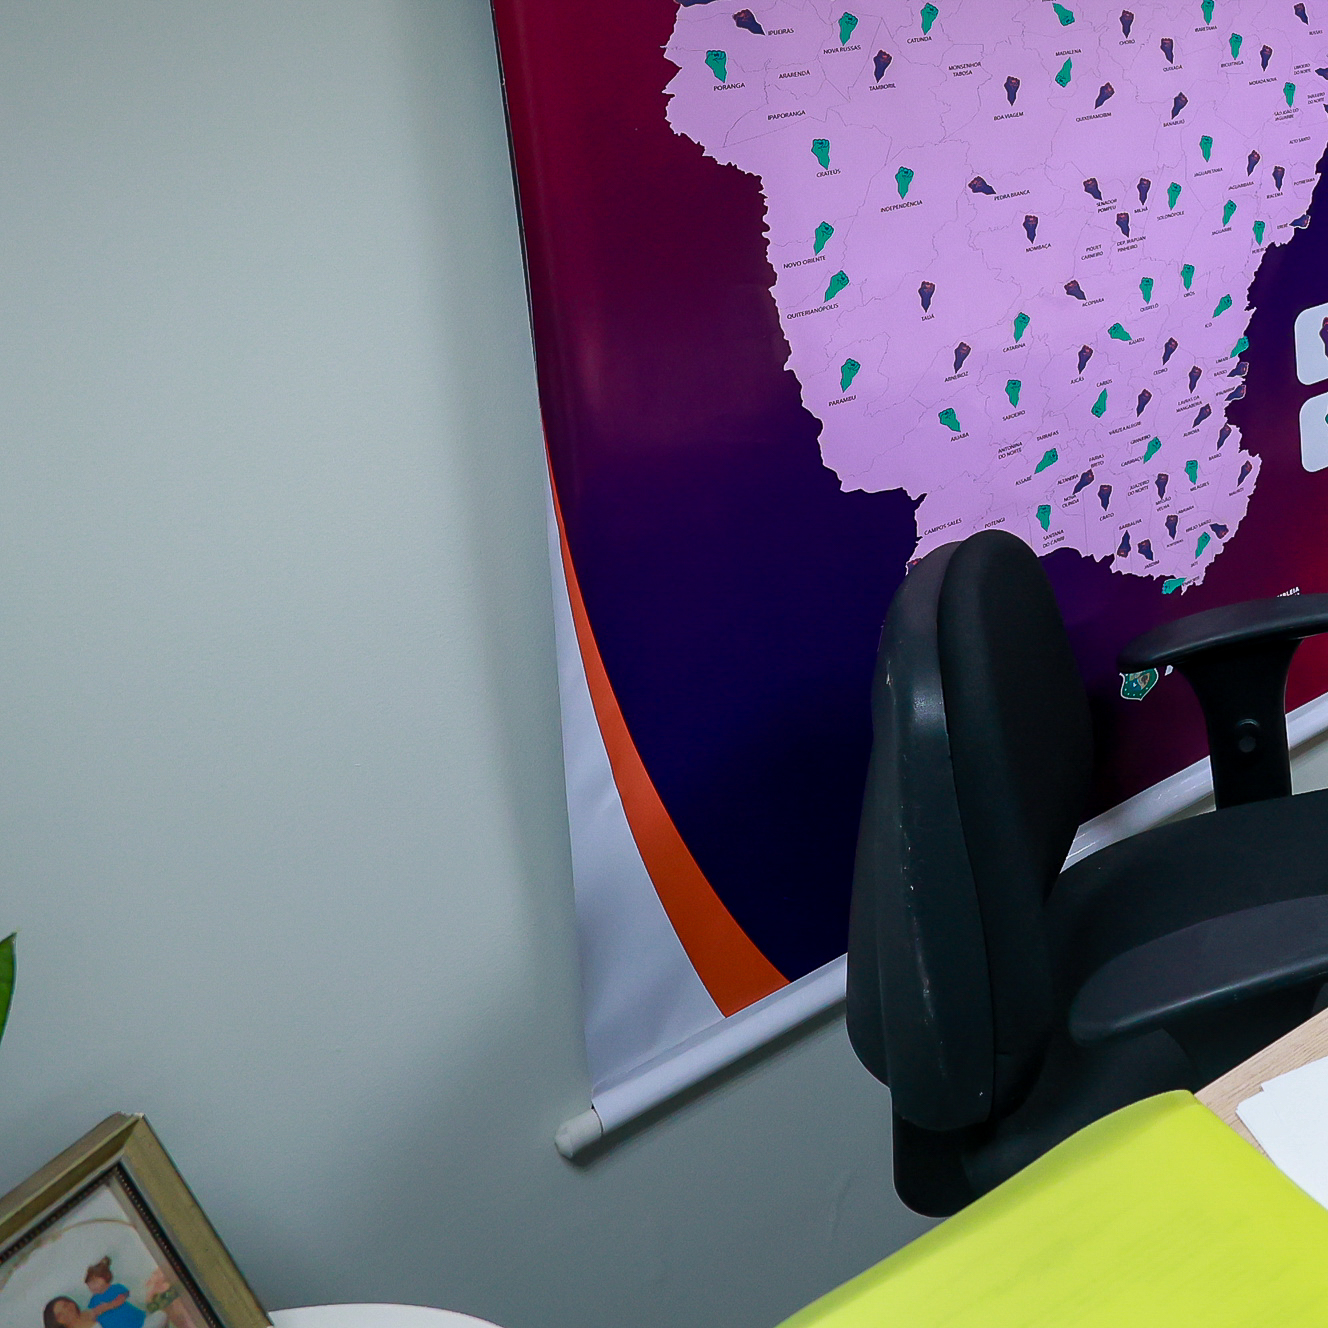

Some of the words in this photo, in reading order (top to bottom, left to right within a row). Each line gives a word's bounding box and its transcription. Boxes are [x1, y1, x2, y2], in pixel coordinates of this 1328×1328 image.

[768, 28, 794, 36] IPUEIRAS
[907, 36, 932, 44] CATUNDA
[840, 45, 861, 53] RUSSAS
[948, 62, 981, 70] MONSENHOR
[714, 83, 745, 91] PORANGA
[768, 110, 805, 120] IPAPORANGA
[1005, 112, 1024, 120] VIAGEM
[816, 168, 841, 178] CRATEÚS
[1011, 190, 1030, 198] BRANCA
[880, 200, 923, 213] INDEPENDÊNCIA
[1098, 205, 1116, 213] POMPEU
[1026, 243, 1051, 253] MOMBAÇA
[1081, 251, 1104, 260] CARNEIRO
[783, 260, 801, 269] NOVO
[803, 255, 826, 265] ORIENTE
[787, 303, 839, 320] QUITERIANÓPOLIS
[1003, 343, 1026, 353] CATARINA
[829, 395, 856, 406] PARAMBU
[1002, 410, 1025, 421] SABOEIRO
[950, 432, 969, 442] AIUABA
[998, 442, 1022, 454] ANTONINA
[1007, 448, 1022, 457] NORTE
[1015, 475, 1032, 486] ASSARÉ
[1100, 513, 1114, 522] CRATO
[924, 522, 946, 536] CAMPOS
[947, 518, 962, 528] SALES
[985, 517, 1005, 529] POTENGI
[1119, 519, 1142, 531] BARBALHA
[1043, 530, 1064, 541] SANTANA
